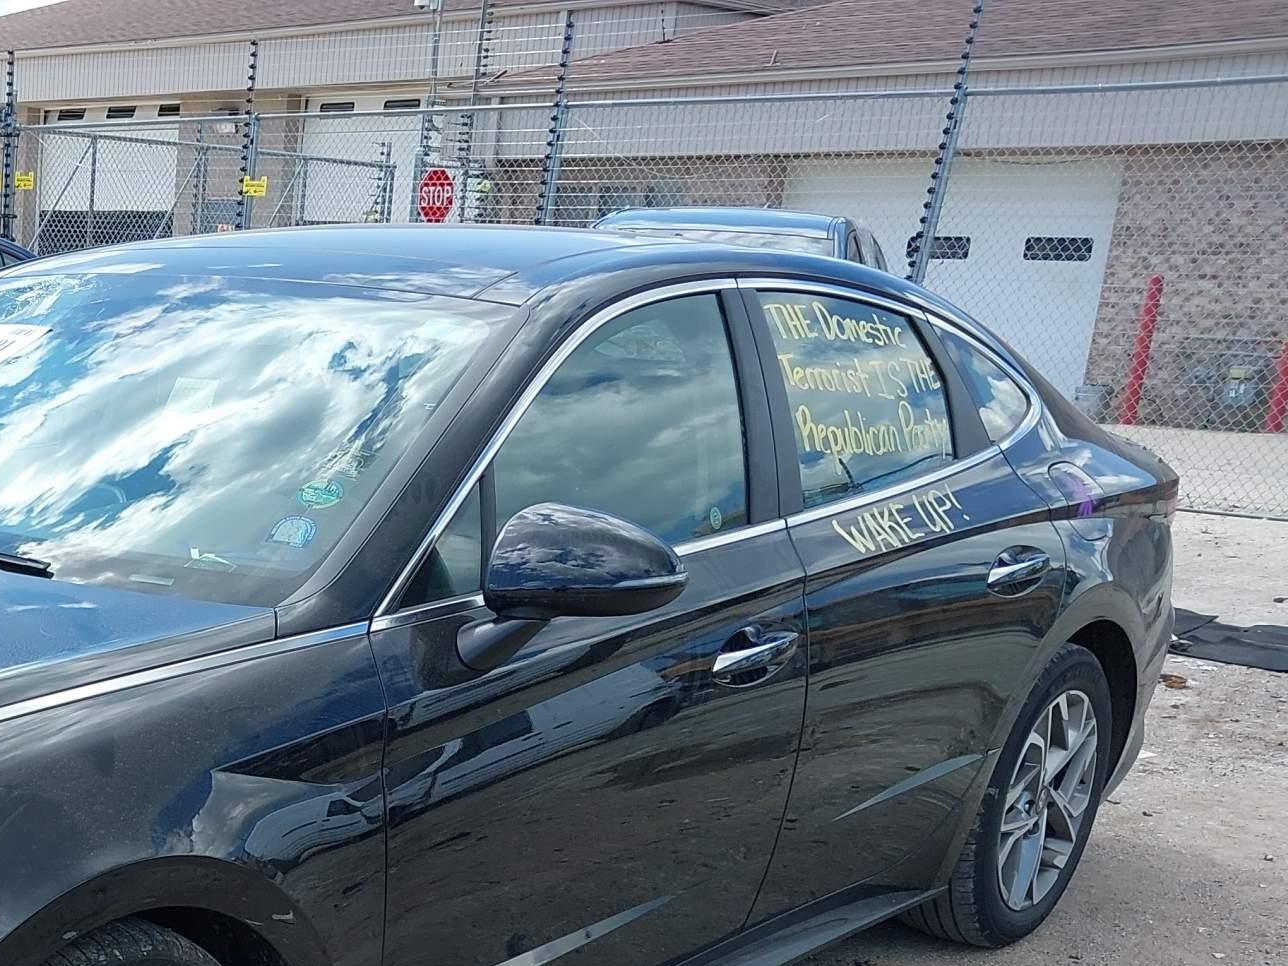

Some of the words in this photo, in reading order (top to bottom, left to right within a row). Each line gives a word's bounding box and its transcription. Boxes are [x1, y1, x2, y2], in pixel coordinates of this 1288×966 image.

[421, 185, 452, 206] STOP
[763, 303, 818, 340] THE
[812, 300, 907, 349] Domestic
[777, 353, 871, 398] Terrorist
[869, 360, 909, 400] IS
[899, 357, 941, 393] THE
[795, 404, 903, 476] Republican
[898, 400, 948, 460] Party
[831, 502, 926, 554] WAKE
[911, 482, 971, 534] UP!
